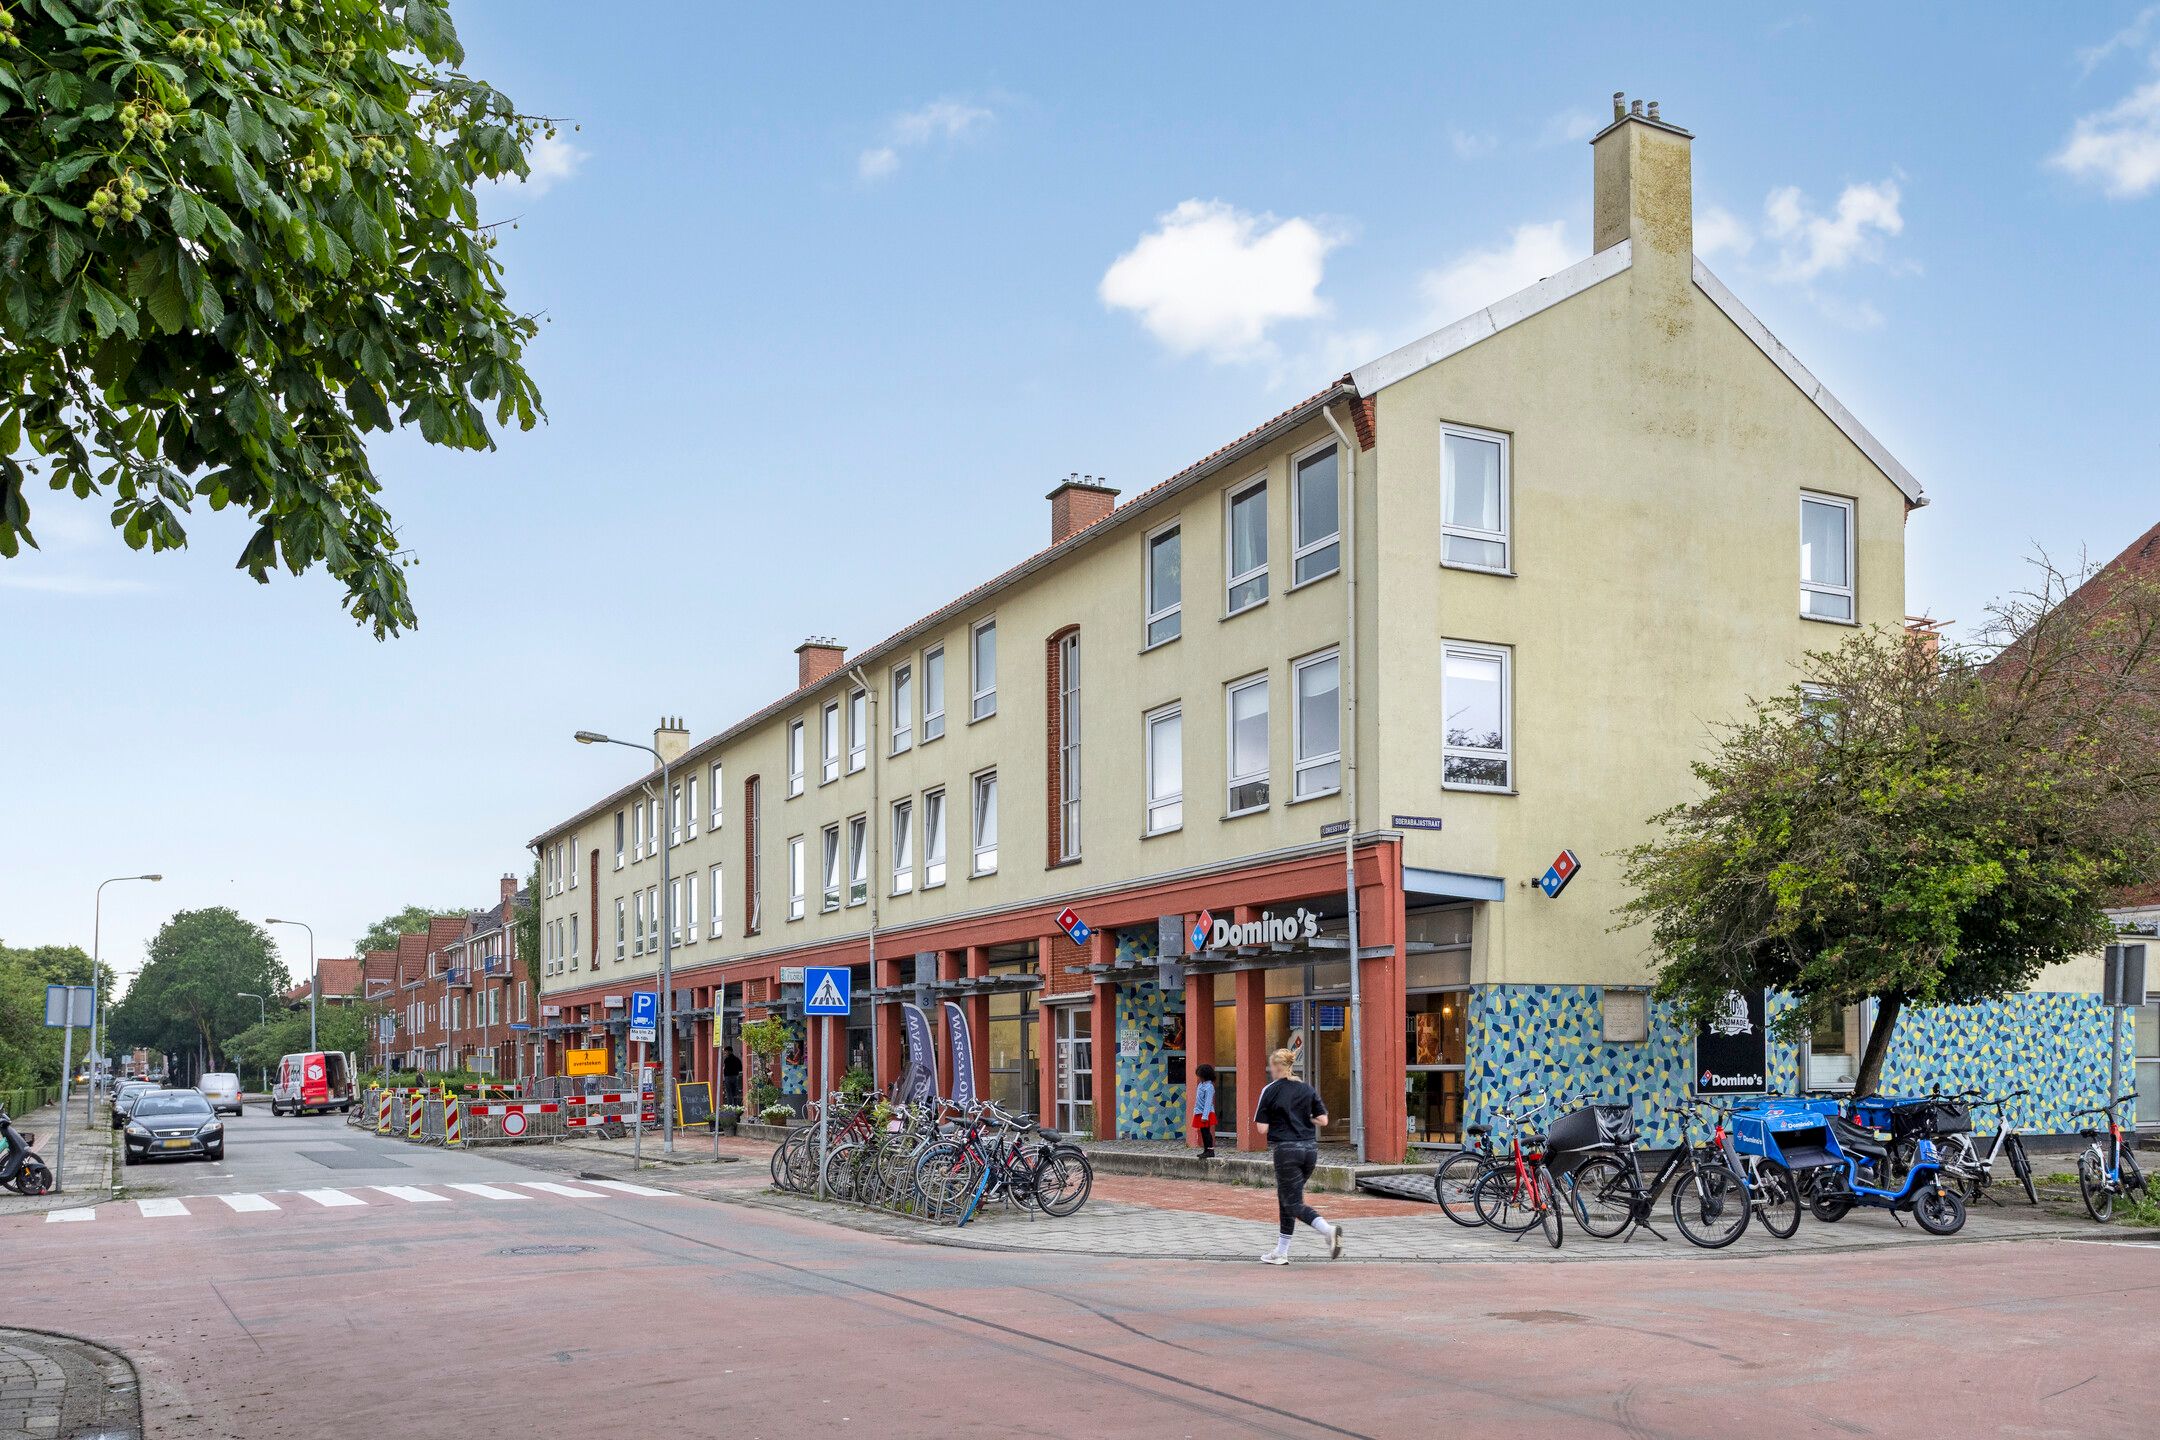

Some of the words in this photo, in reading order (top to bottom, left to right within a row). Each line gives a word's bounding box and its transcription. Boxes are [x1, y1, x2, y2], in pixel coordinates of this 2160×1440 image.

[1322, 822, 1350, 835] LORESSTRAA
[1395, 818, 1441, 828] SOERABAJASTRAAT
[1213, 907, 1318, 949] Domino's
[1169, 975, 1173, 986] 1
[637, 995, 652, 1014] P
[923, 998, 929, 1006] 3
[1712, 1073, 1763, 1087] Domino's
[1787, 1121, 1814, 1129] Domino's
[1743, 1135, 1763, 1145] Domino's
